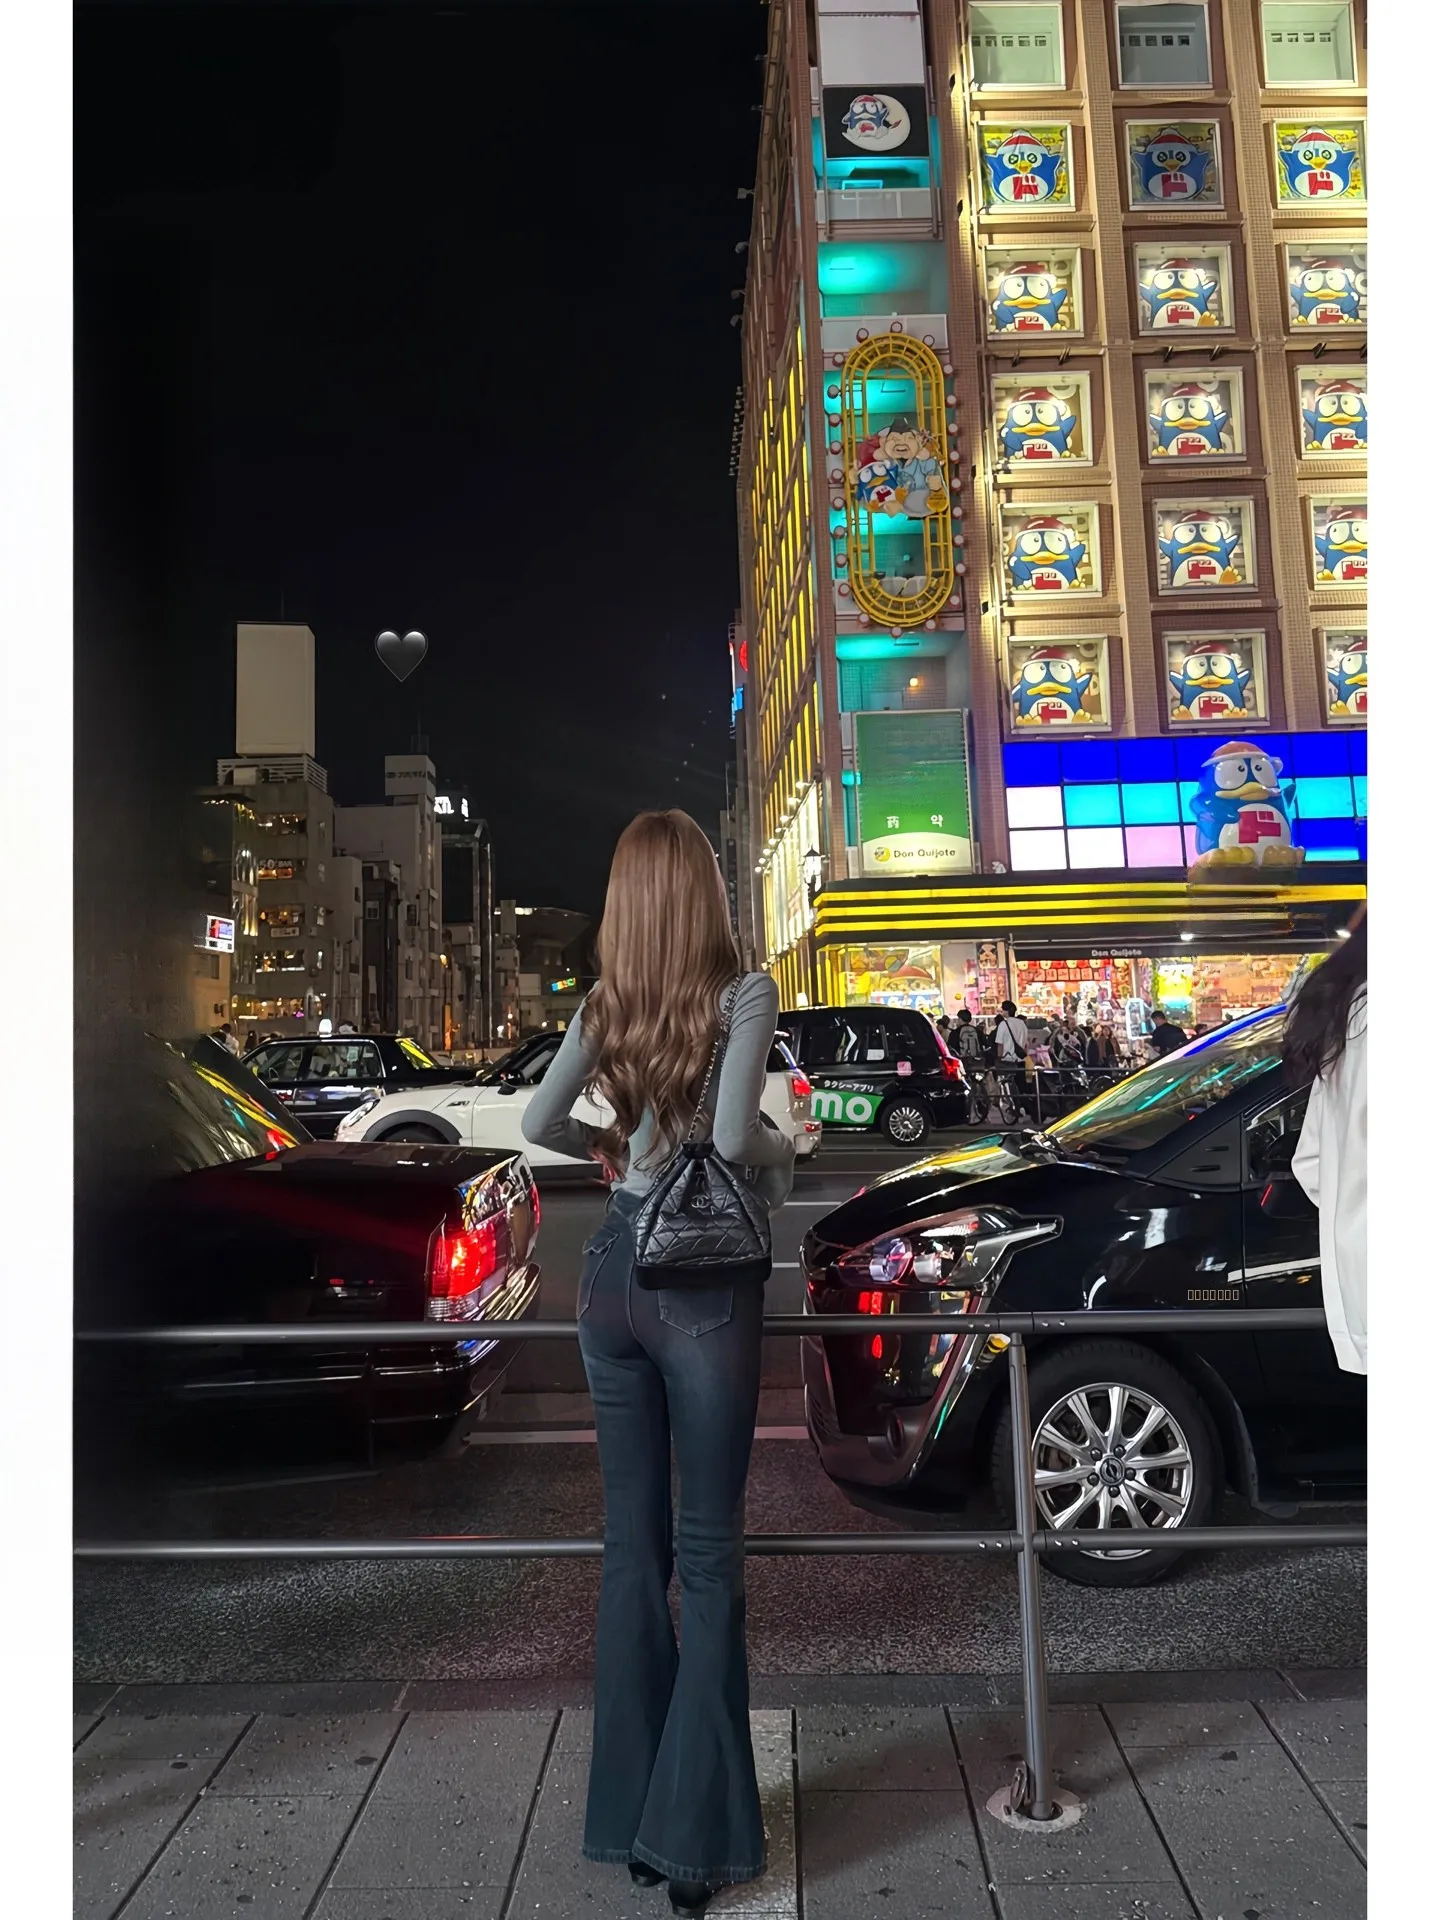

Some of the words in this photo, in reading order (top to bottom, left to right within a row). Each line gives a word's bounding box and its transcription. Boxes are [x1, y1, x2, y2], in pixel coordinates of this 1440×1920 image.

[1012, 175, 1039, 200] ド
[1161, 172, 1188, 197] ド
[1307, 171, 1334, 196] ド
[1238, 811, 1281, 844] ド
[893, 850, 914, 858] Don
[917, 848, 956, 859] Quijote
[823, 1079, 875, 1093] タクシーアプリ
